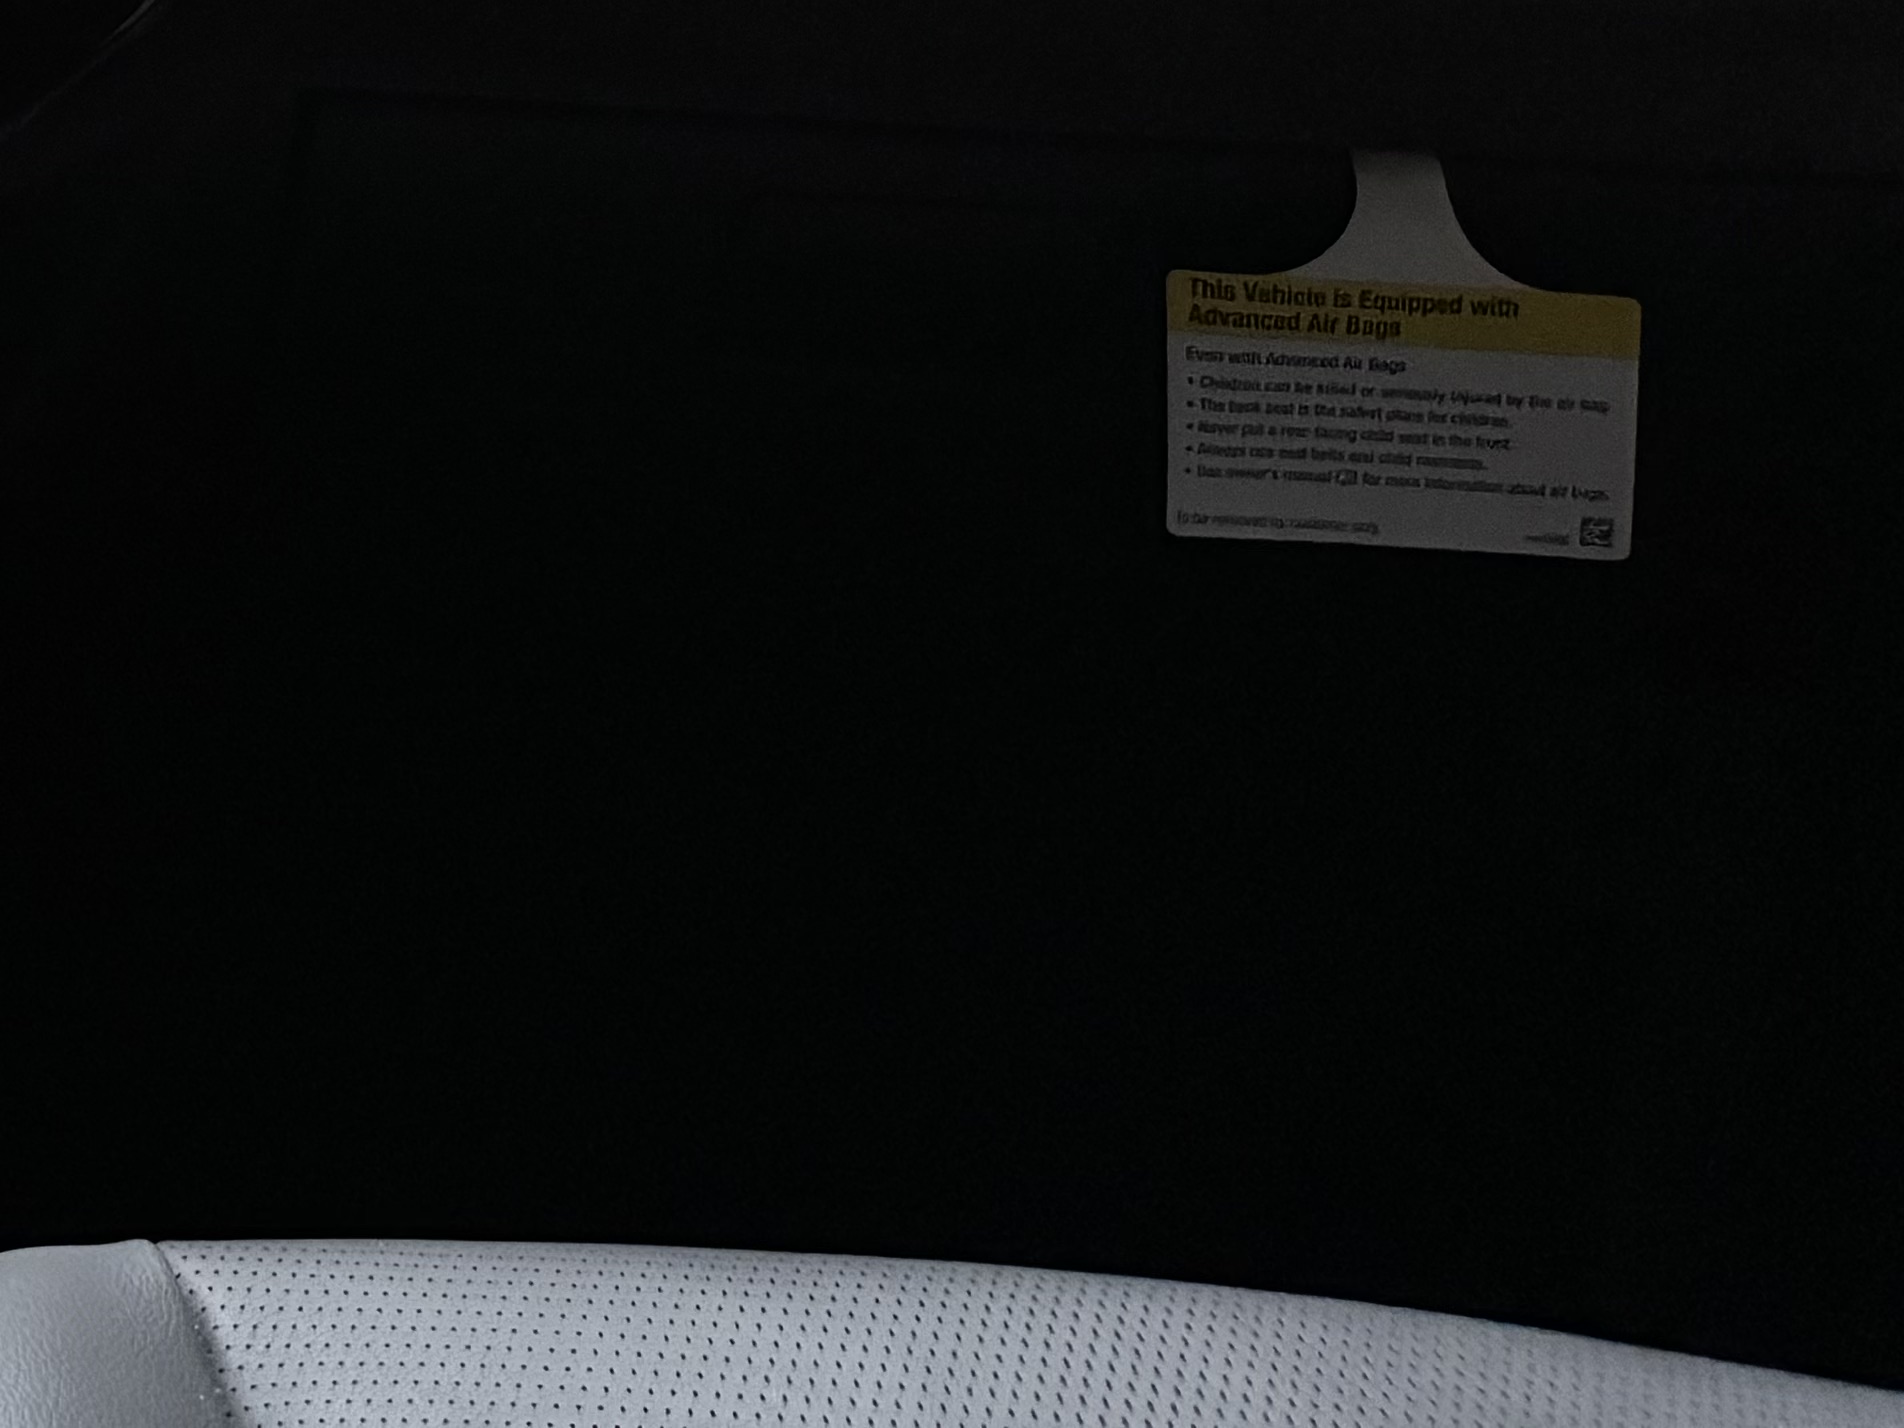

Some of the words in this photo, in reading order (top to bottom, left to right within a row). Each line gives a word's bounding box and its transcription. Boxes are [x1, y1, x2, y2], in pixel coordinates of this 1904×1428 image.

[1190, 278, 1236, 302] This
[1243, 280, 1326, 308] Vehicle
[1333, 288, 1352, 309] is
[1359, 289, 1463, 318] Equipped
[1471, 295, 1520, 319] with
[1188, 303, 1301, 332] Advanced
[1307, 312, 1340, 335] Air
[1345, 314, 1402, 340] Bags
